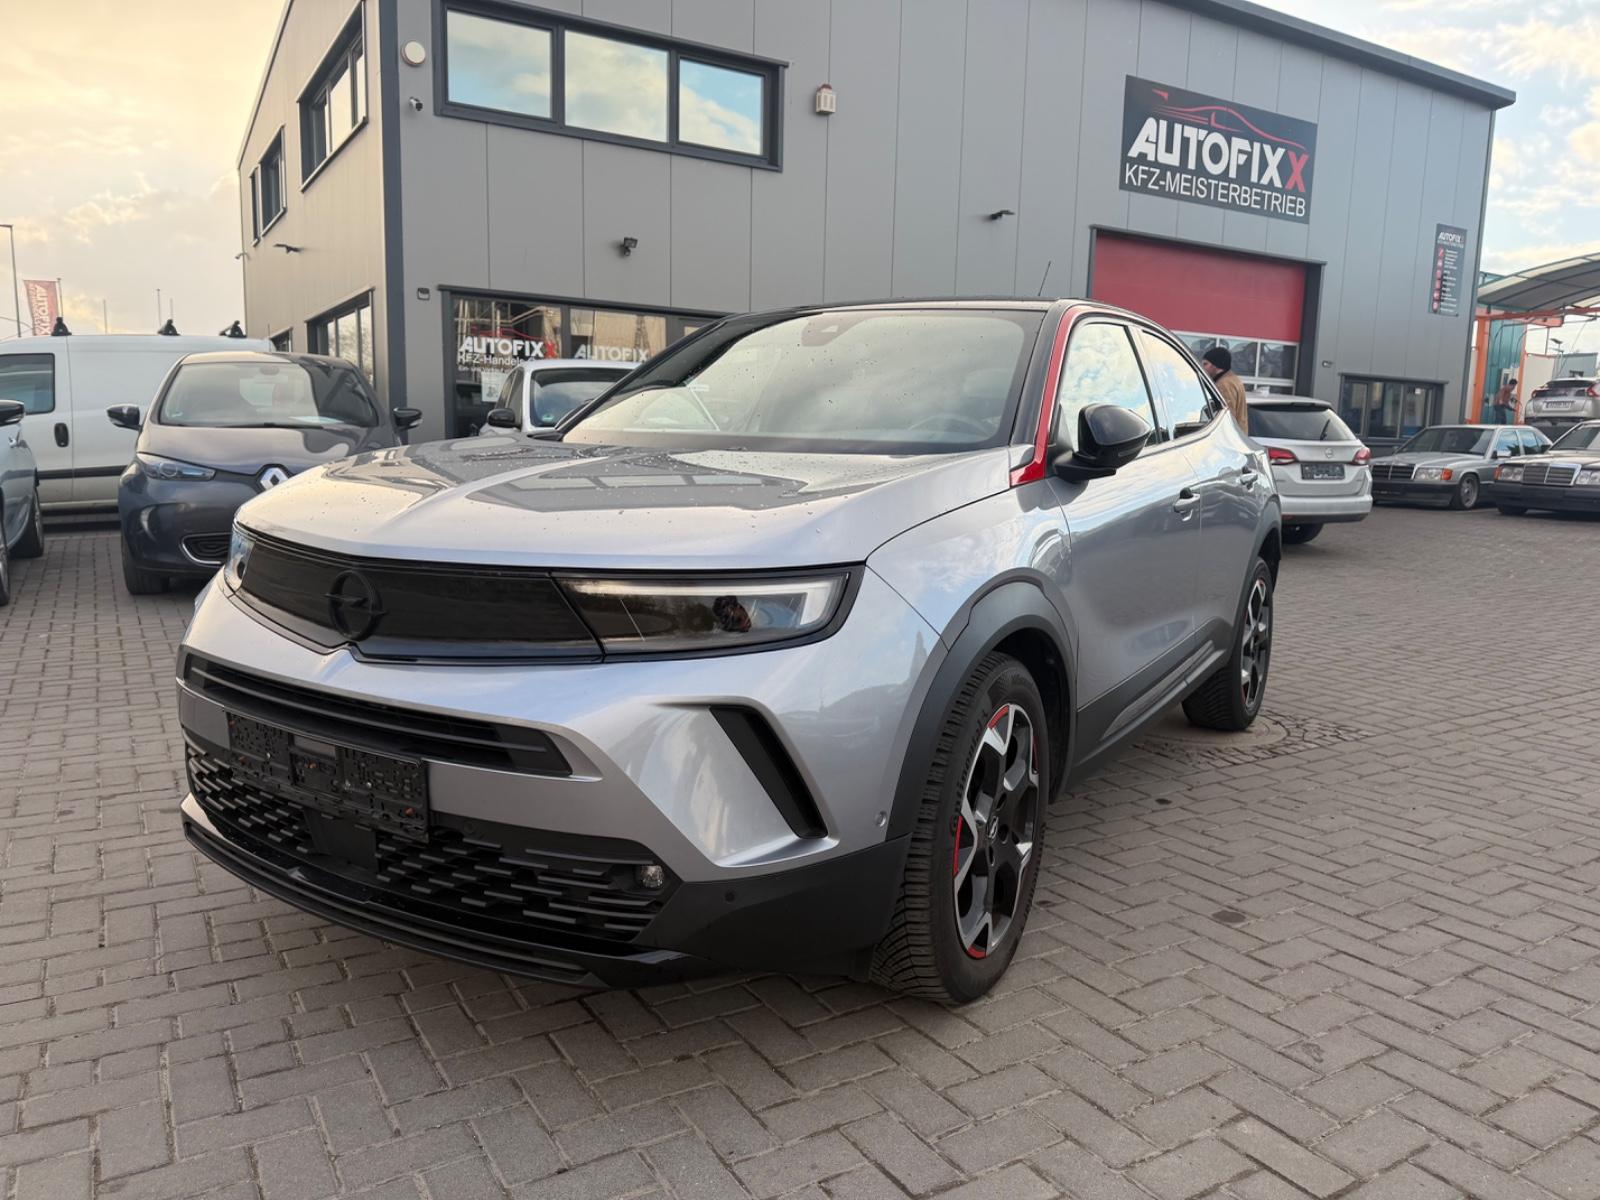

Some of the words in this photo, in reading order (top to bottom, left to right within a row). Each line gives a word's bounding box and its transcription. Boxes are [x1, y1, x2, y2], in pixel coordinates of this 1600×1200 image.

[1127, 117, 1309, 193] AUTOFIXX
[1125, 163, 1306, 217] KFZ-MEISTERBETRIEB
[459, 335, 557, 359] AUTOFIXX
